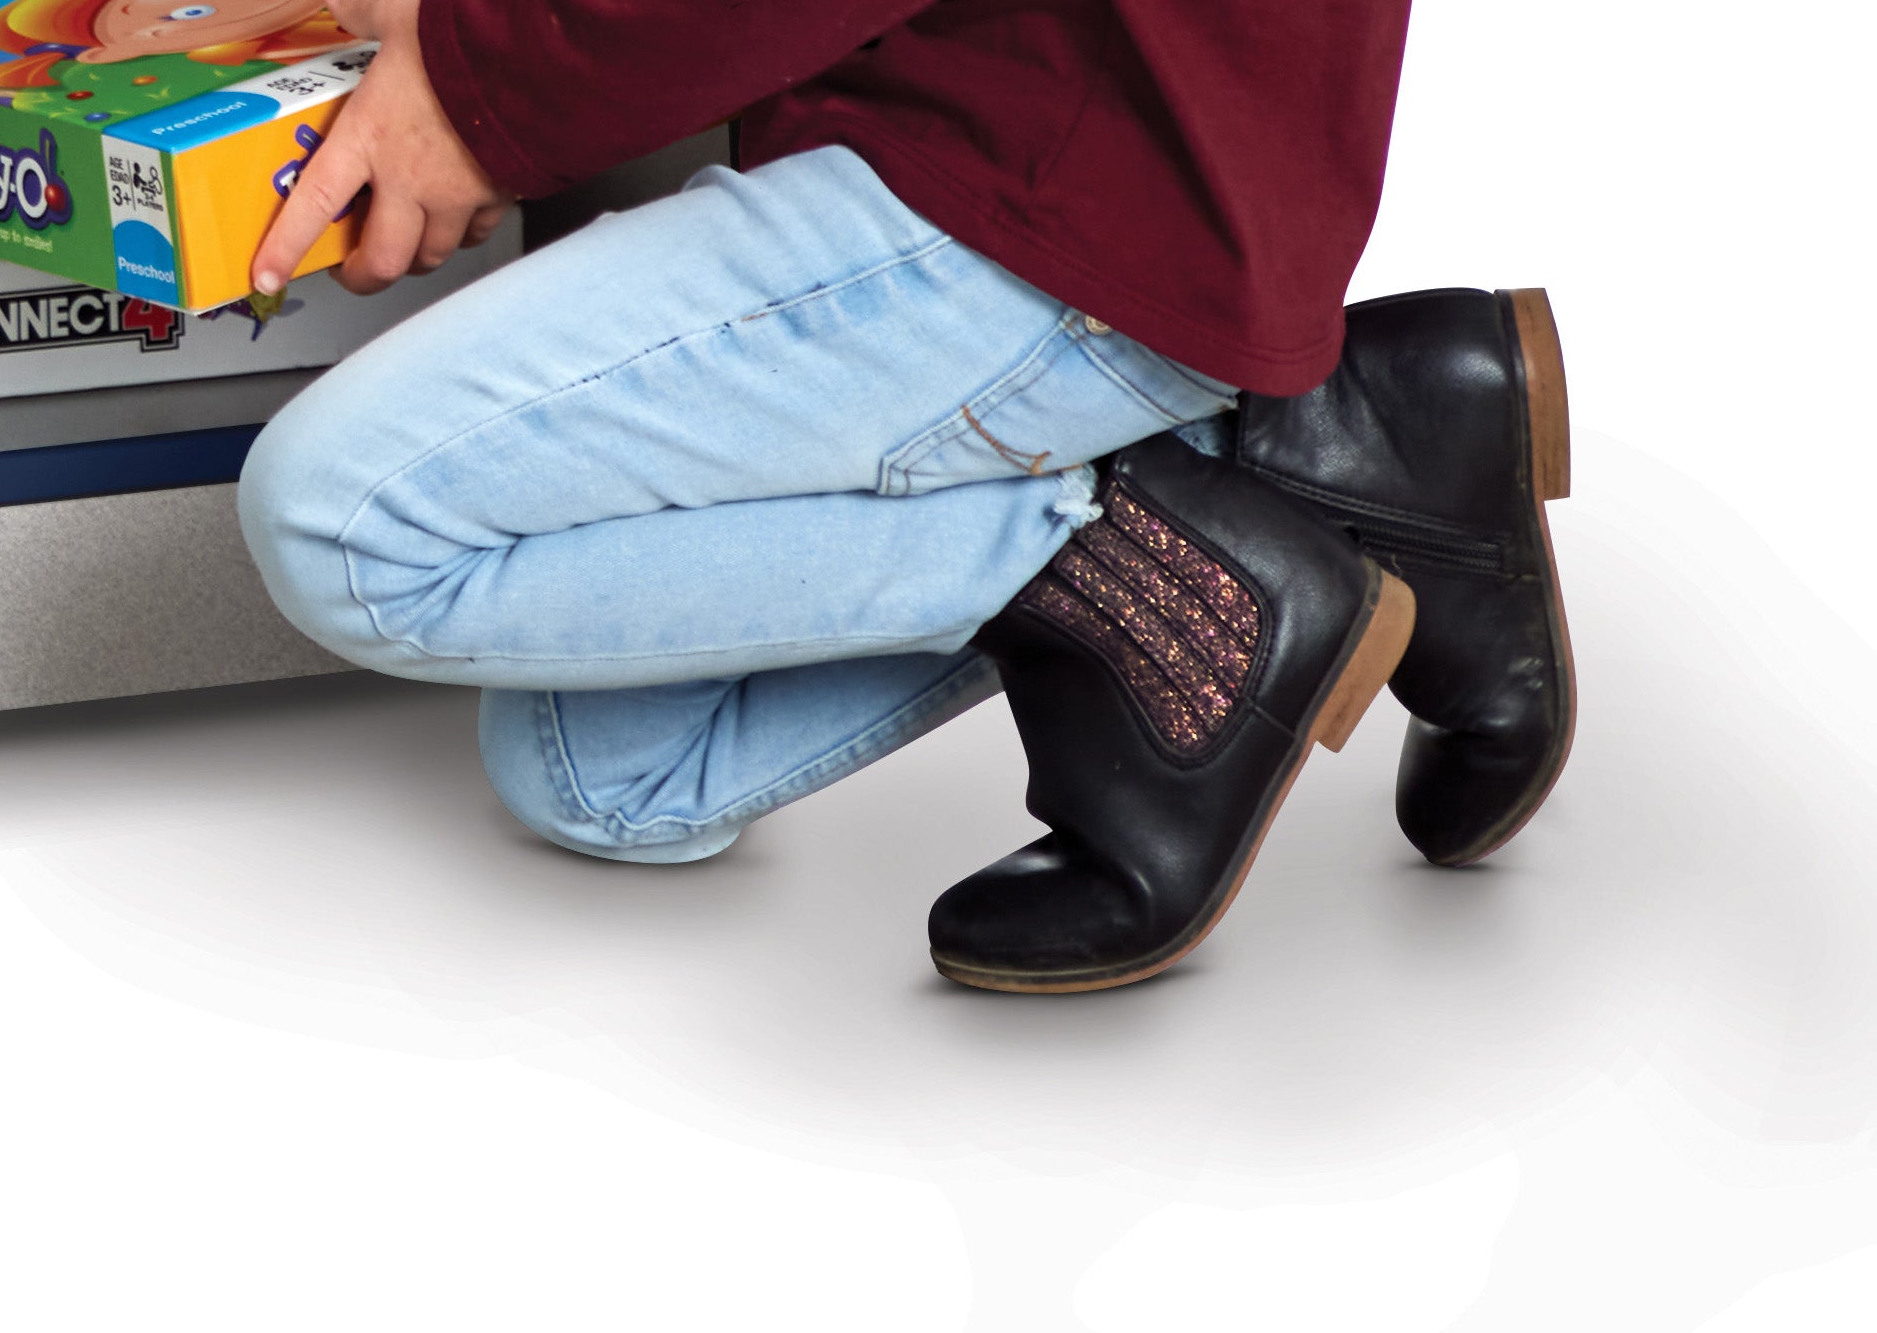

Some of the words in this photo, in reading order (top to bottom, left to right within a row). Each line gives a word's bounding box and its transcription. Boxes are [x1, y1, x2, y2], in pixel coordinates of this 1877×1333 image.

[151, 101, 247, 135] Preschool
[109, 156, 124, 172] AGE
[110, 170, 130, 186] EDAD
[111, 185, 133, 207] 3+
[117, 256, 176, 284] Preschool
[122, 296, 177, 342] 4
